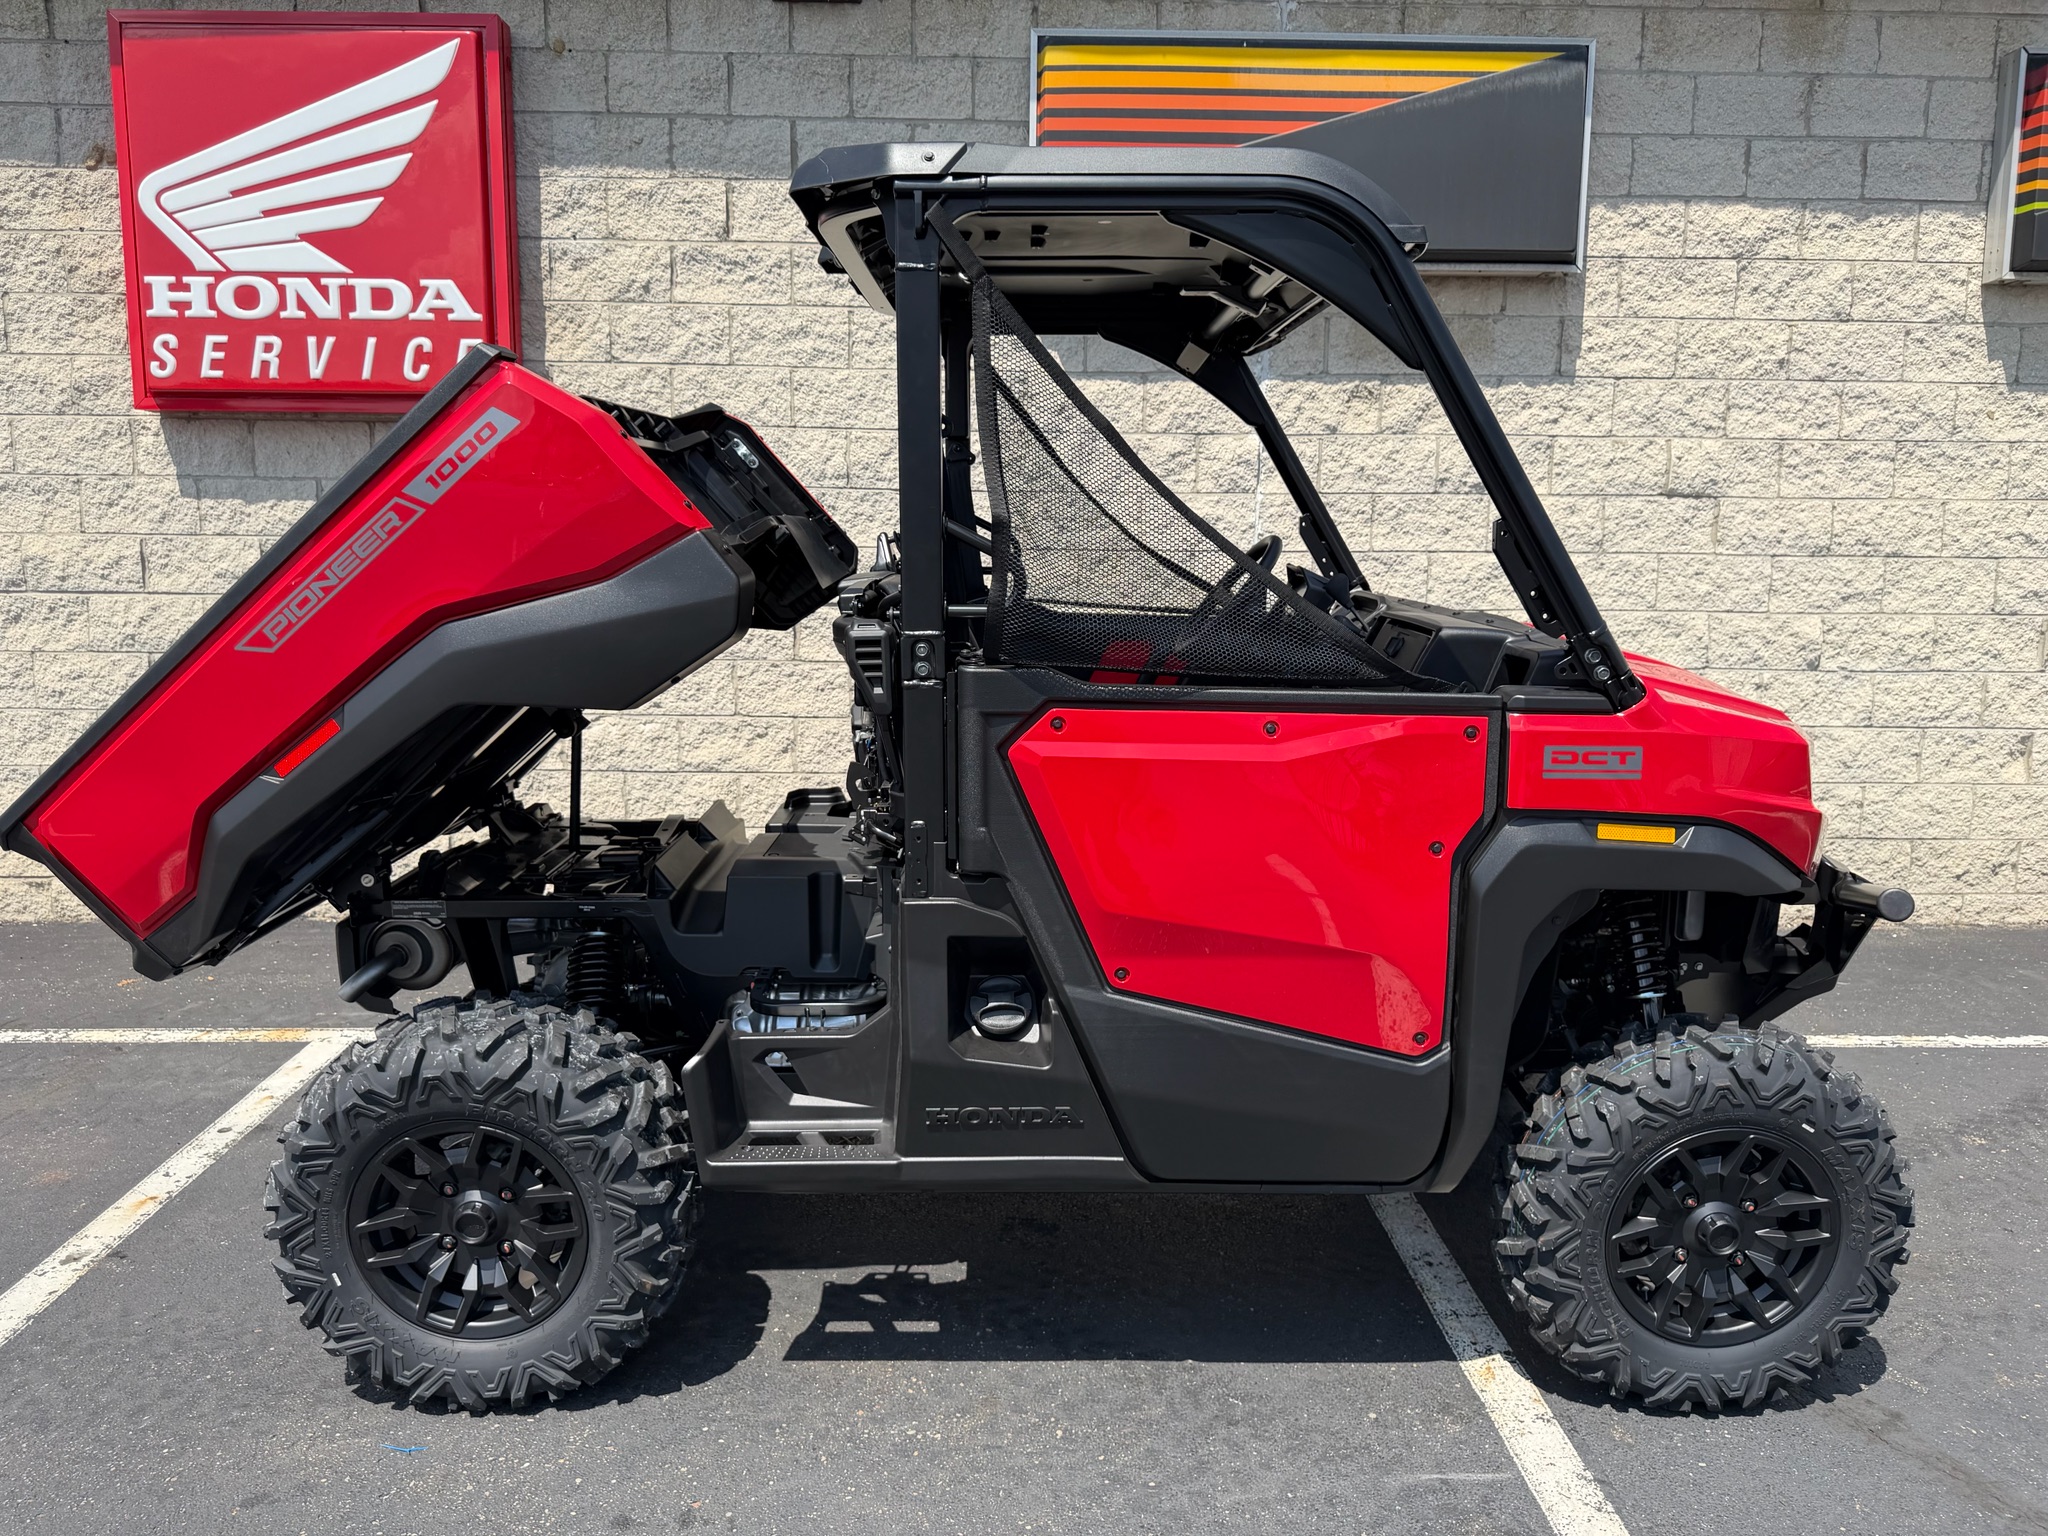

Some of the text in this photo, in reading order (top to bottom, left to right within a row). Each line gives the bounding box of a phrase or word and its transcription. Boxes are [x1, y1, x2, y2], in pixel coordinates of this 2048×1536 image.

[143, 276, 483, 321] HONDA
[262, 420, 498, 642] PIONEER 1000
[1551, 751, 1636, 766] DCT
[925, 1106, 1084, 1129] HONDA
